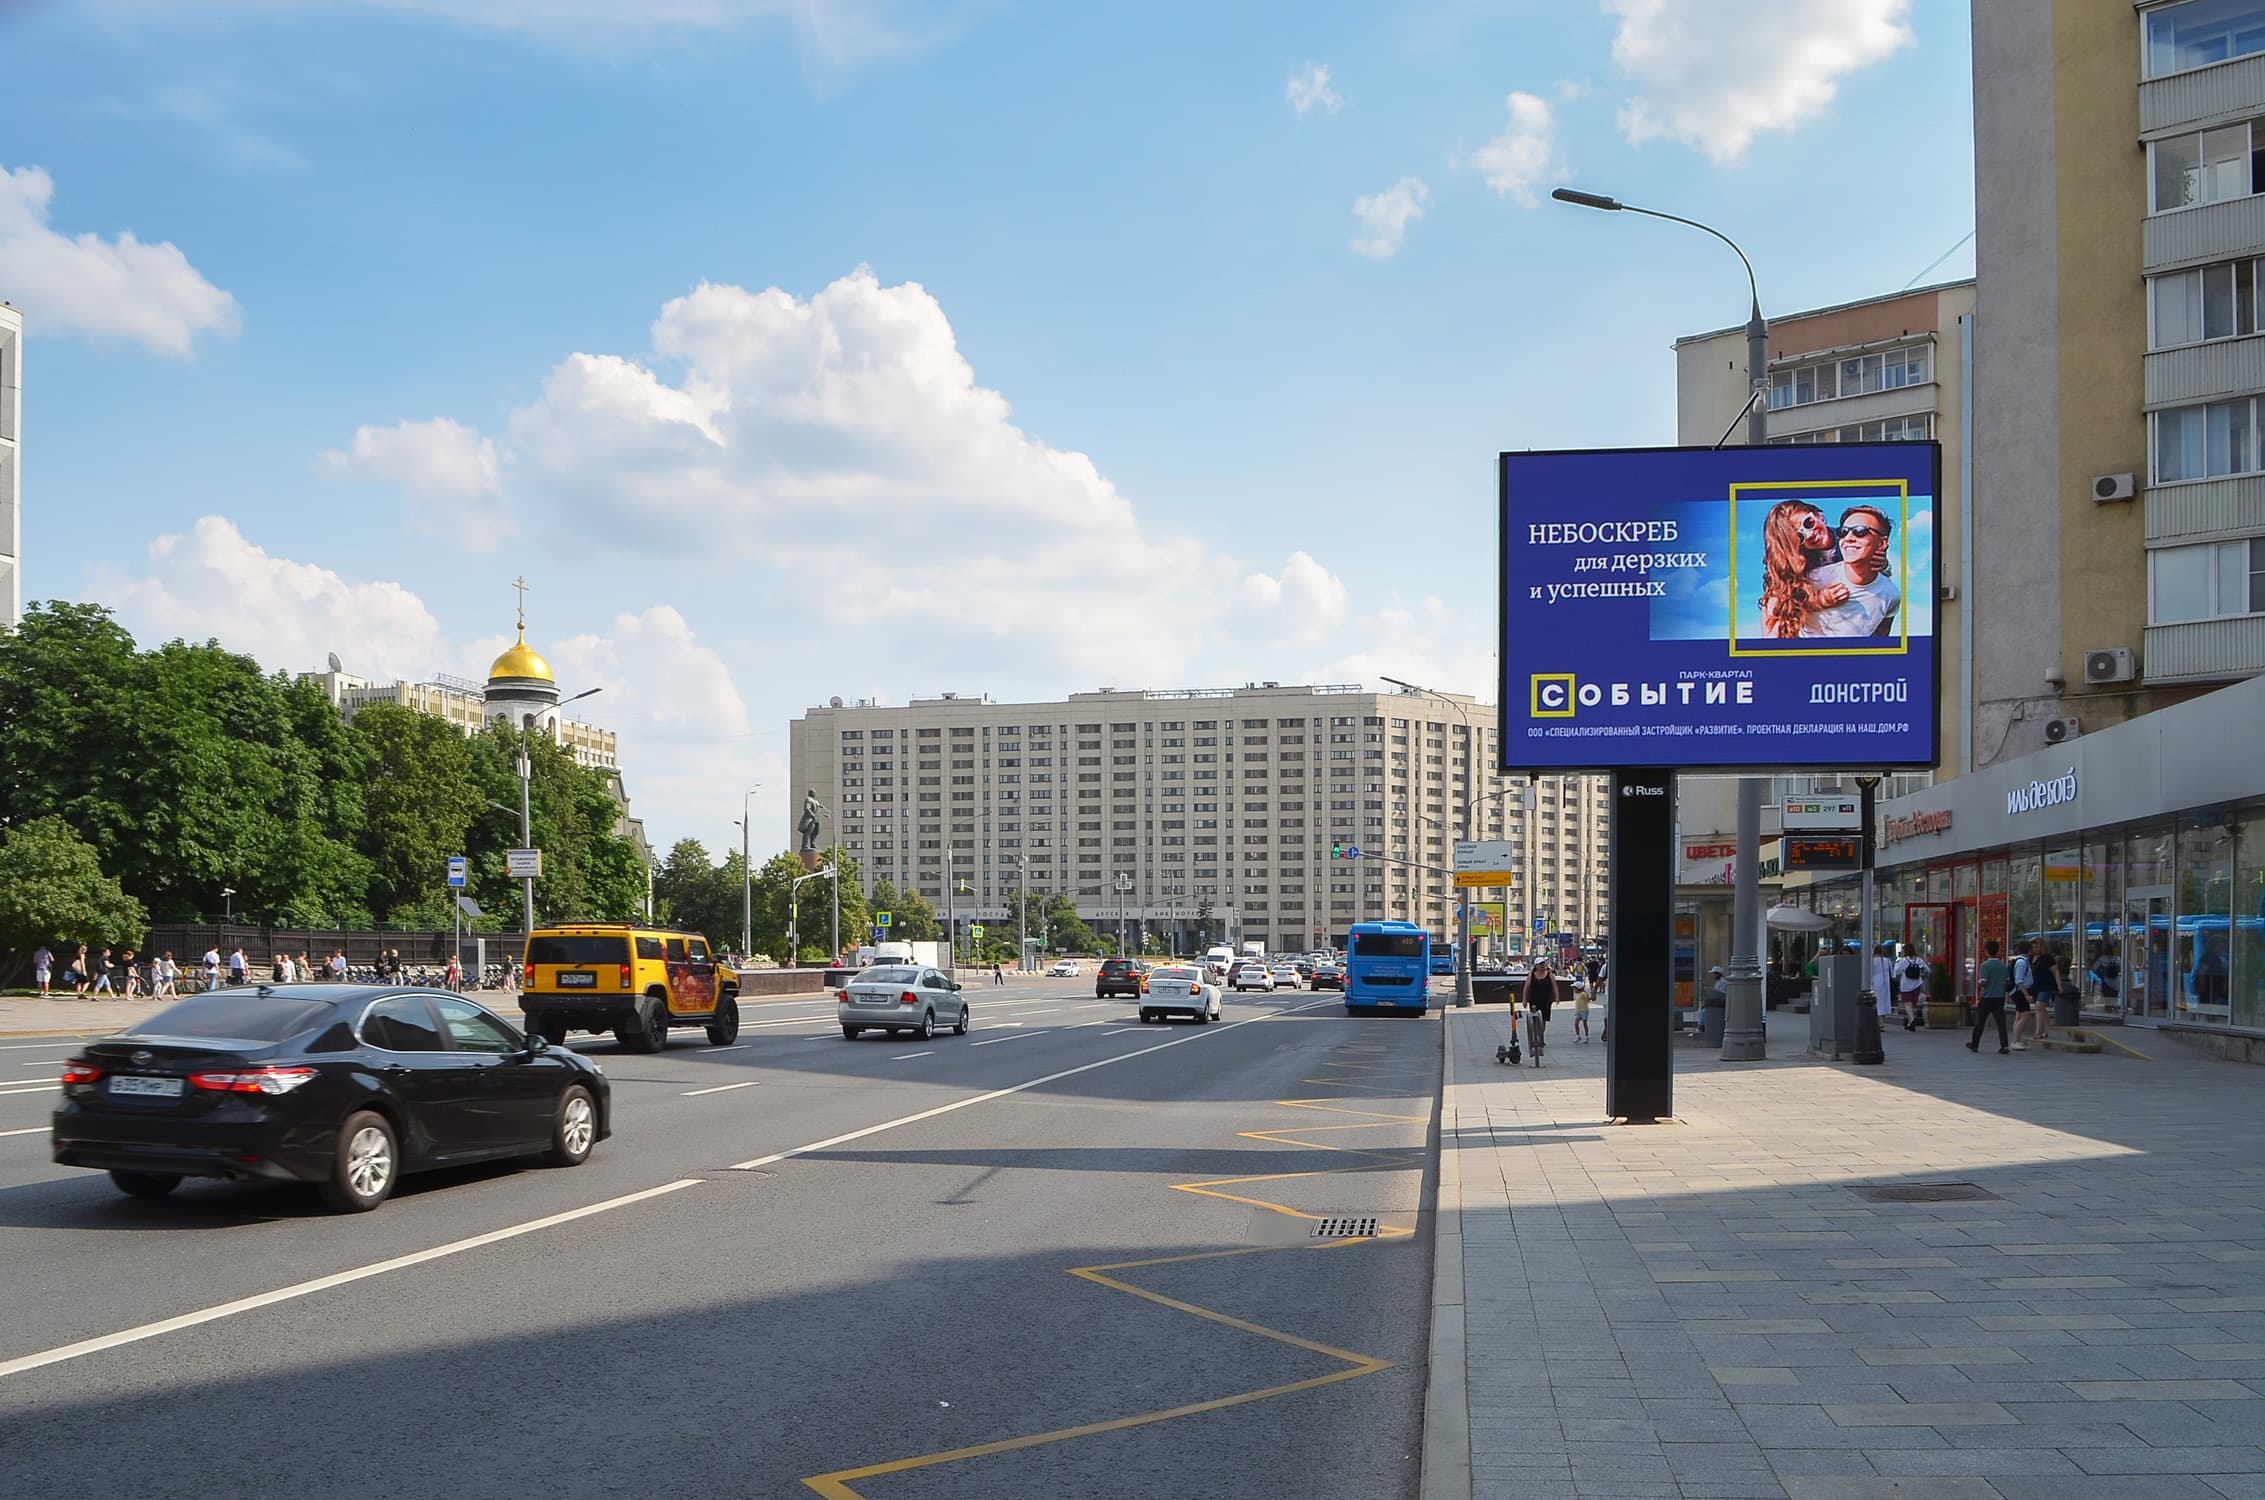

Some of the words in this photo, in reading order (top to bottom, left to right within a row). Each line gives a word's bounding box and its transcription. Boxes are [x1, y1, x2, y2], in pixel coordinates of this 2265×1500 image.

[1528, 521, 1678, 544] НЕБОСКРЕБ
[1574, 557, 1607, 572] для
[1611, 552, 1707, 575] дерзких
[1530, 586, 1542, 599] и
[1547, 581, 1666, 605] успешных
[1541, 681, 1753, 706] СОБЫТИЕ
[1809, 678, 1907, 704] ДОНСТРОЙ
[1527, 727, 1543, 738] ООО
[1545, 724, 1640, 738] «СПЕЦИАЛИЗИРОВАННЫЙ
[1641, 723, 1694, 737] ЗАСТРОЙЩИК
[1747, 723, 1792, 735] ПРОЕКТНАЯ
[1793, 722, 1844, 736] ДЕКЛАРАЦИЯ
[1846, 723, 1856, 733] НА
[1636, 785, 1664, 796] Russ
